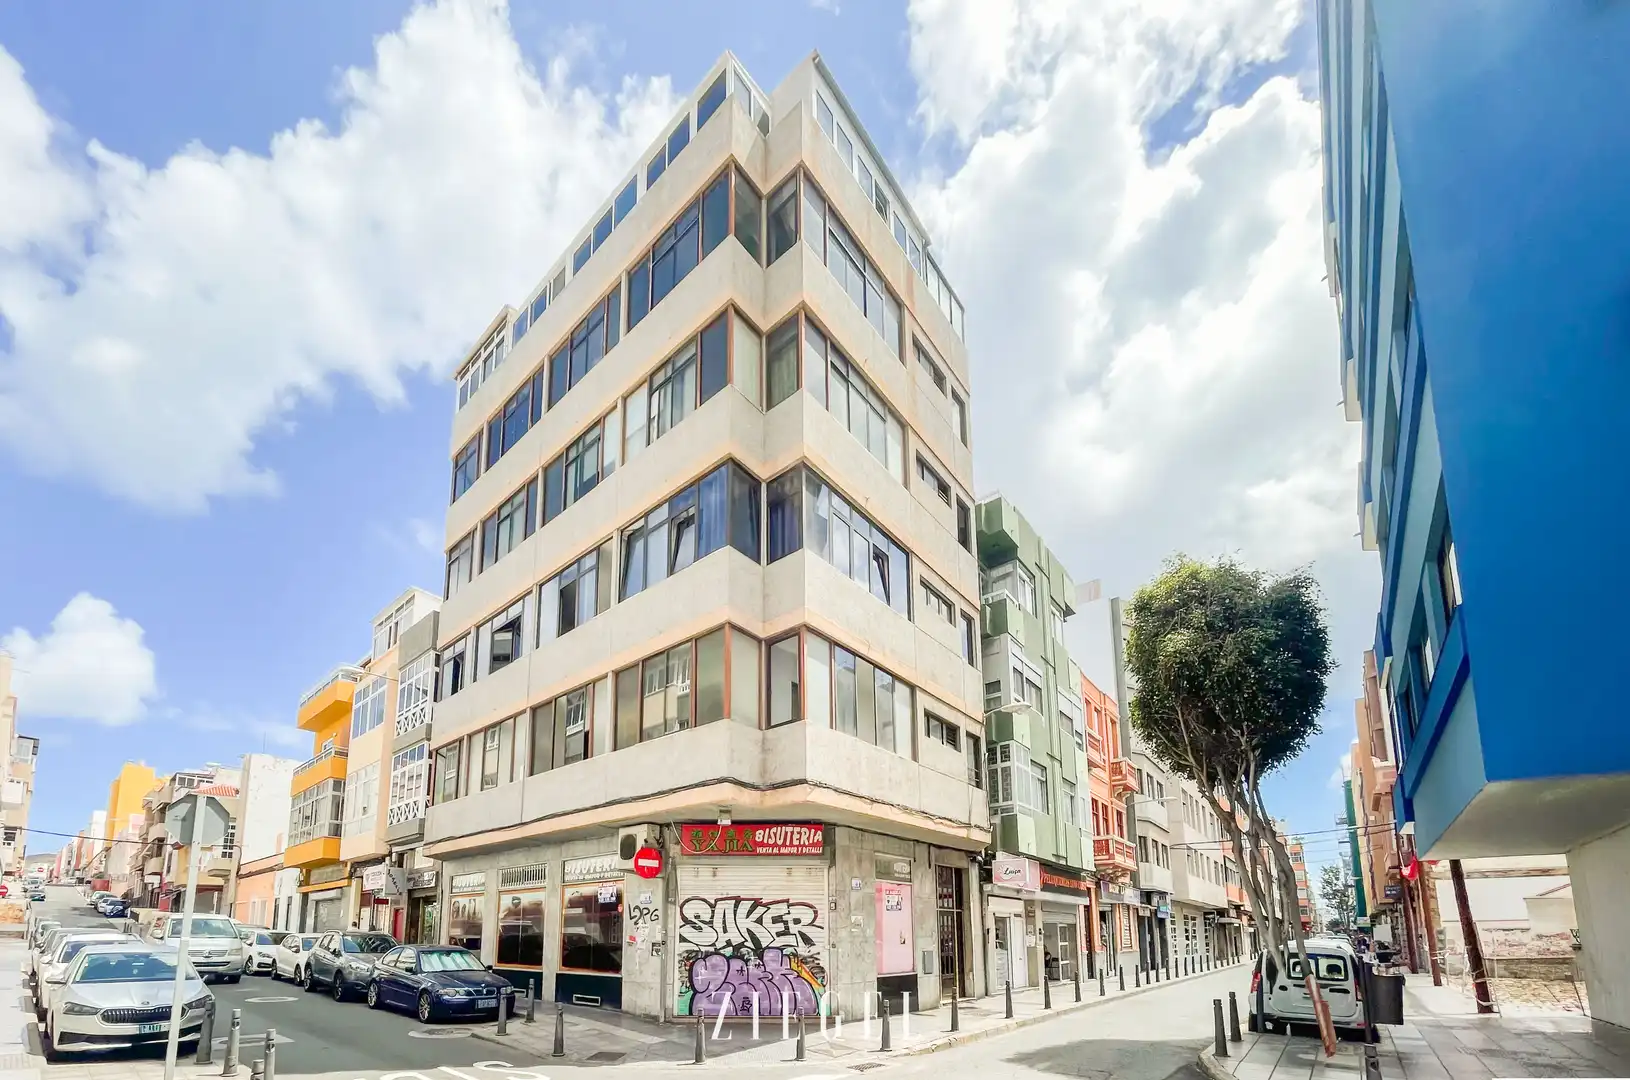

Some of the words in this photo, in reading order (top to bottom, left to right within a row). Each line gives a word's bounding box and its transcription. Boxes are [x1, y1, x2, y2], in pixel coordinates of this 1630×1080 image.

[755, 826, 823, 846] BISUTERIA
[756, 846, 773, 854] VENTA
[803, 846, 823, 854] DETALLE
[679, 896, 824, 951] SAKER
